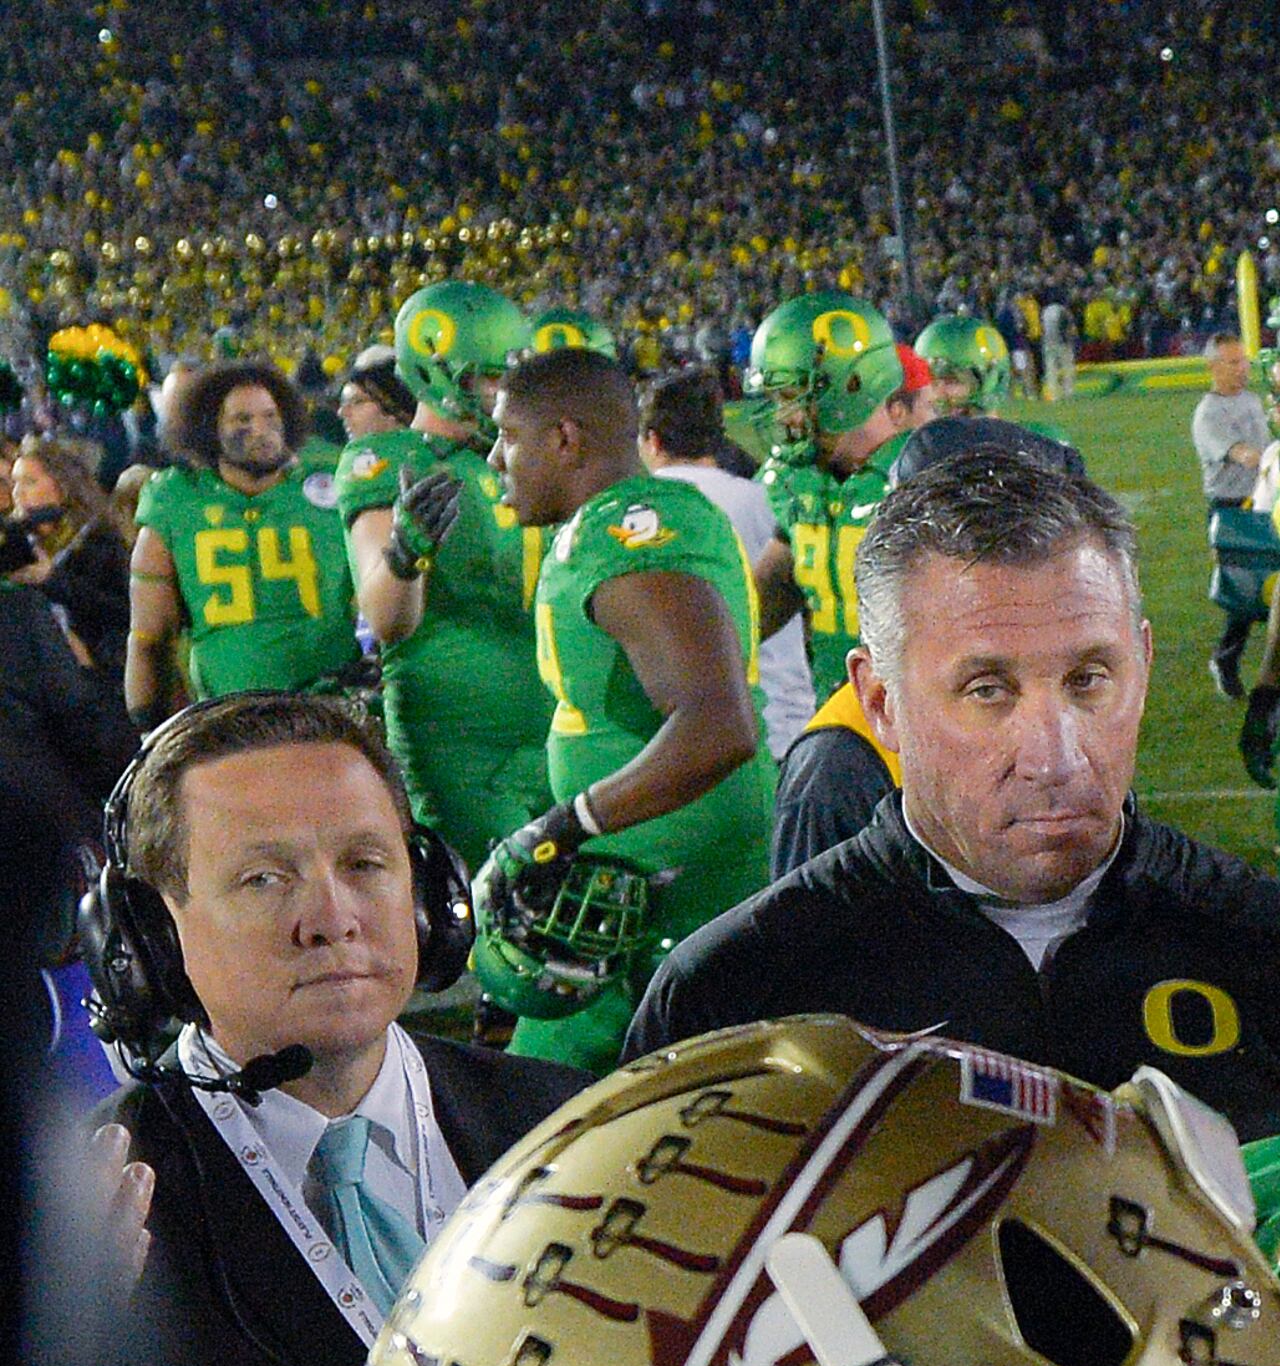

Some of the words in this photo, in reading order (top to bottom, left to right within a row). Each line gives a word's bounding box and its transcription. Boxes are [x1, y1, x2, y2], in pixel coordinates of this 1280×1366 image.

[812, 309, 870, 358] O
[194, 525, 322, 626] 54
[1142, 978, 1241, 1058] O
